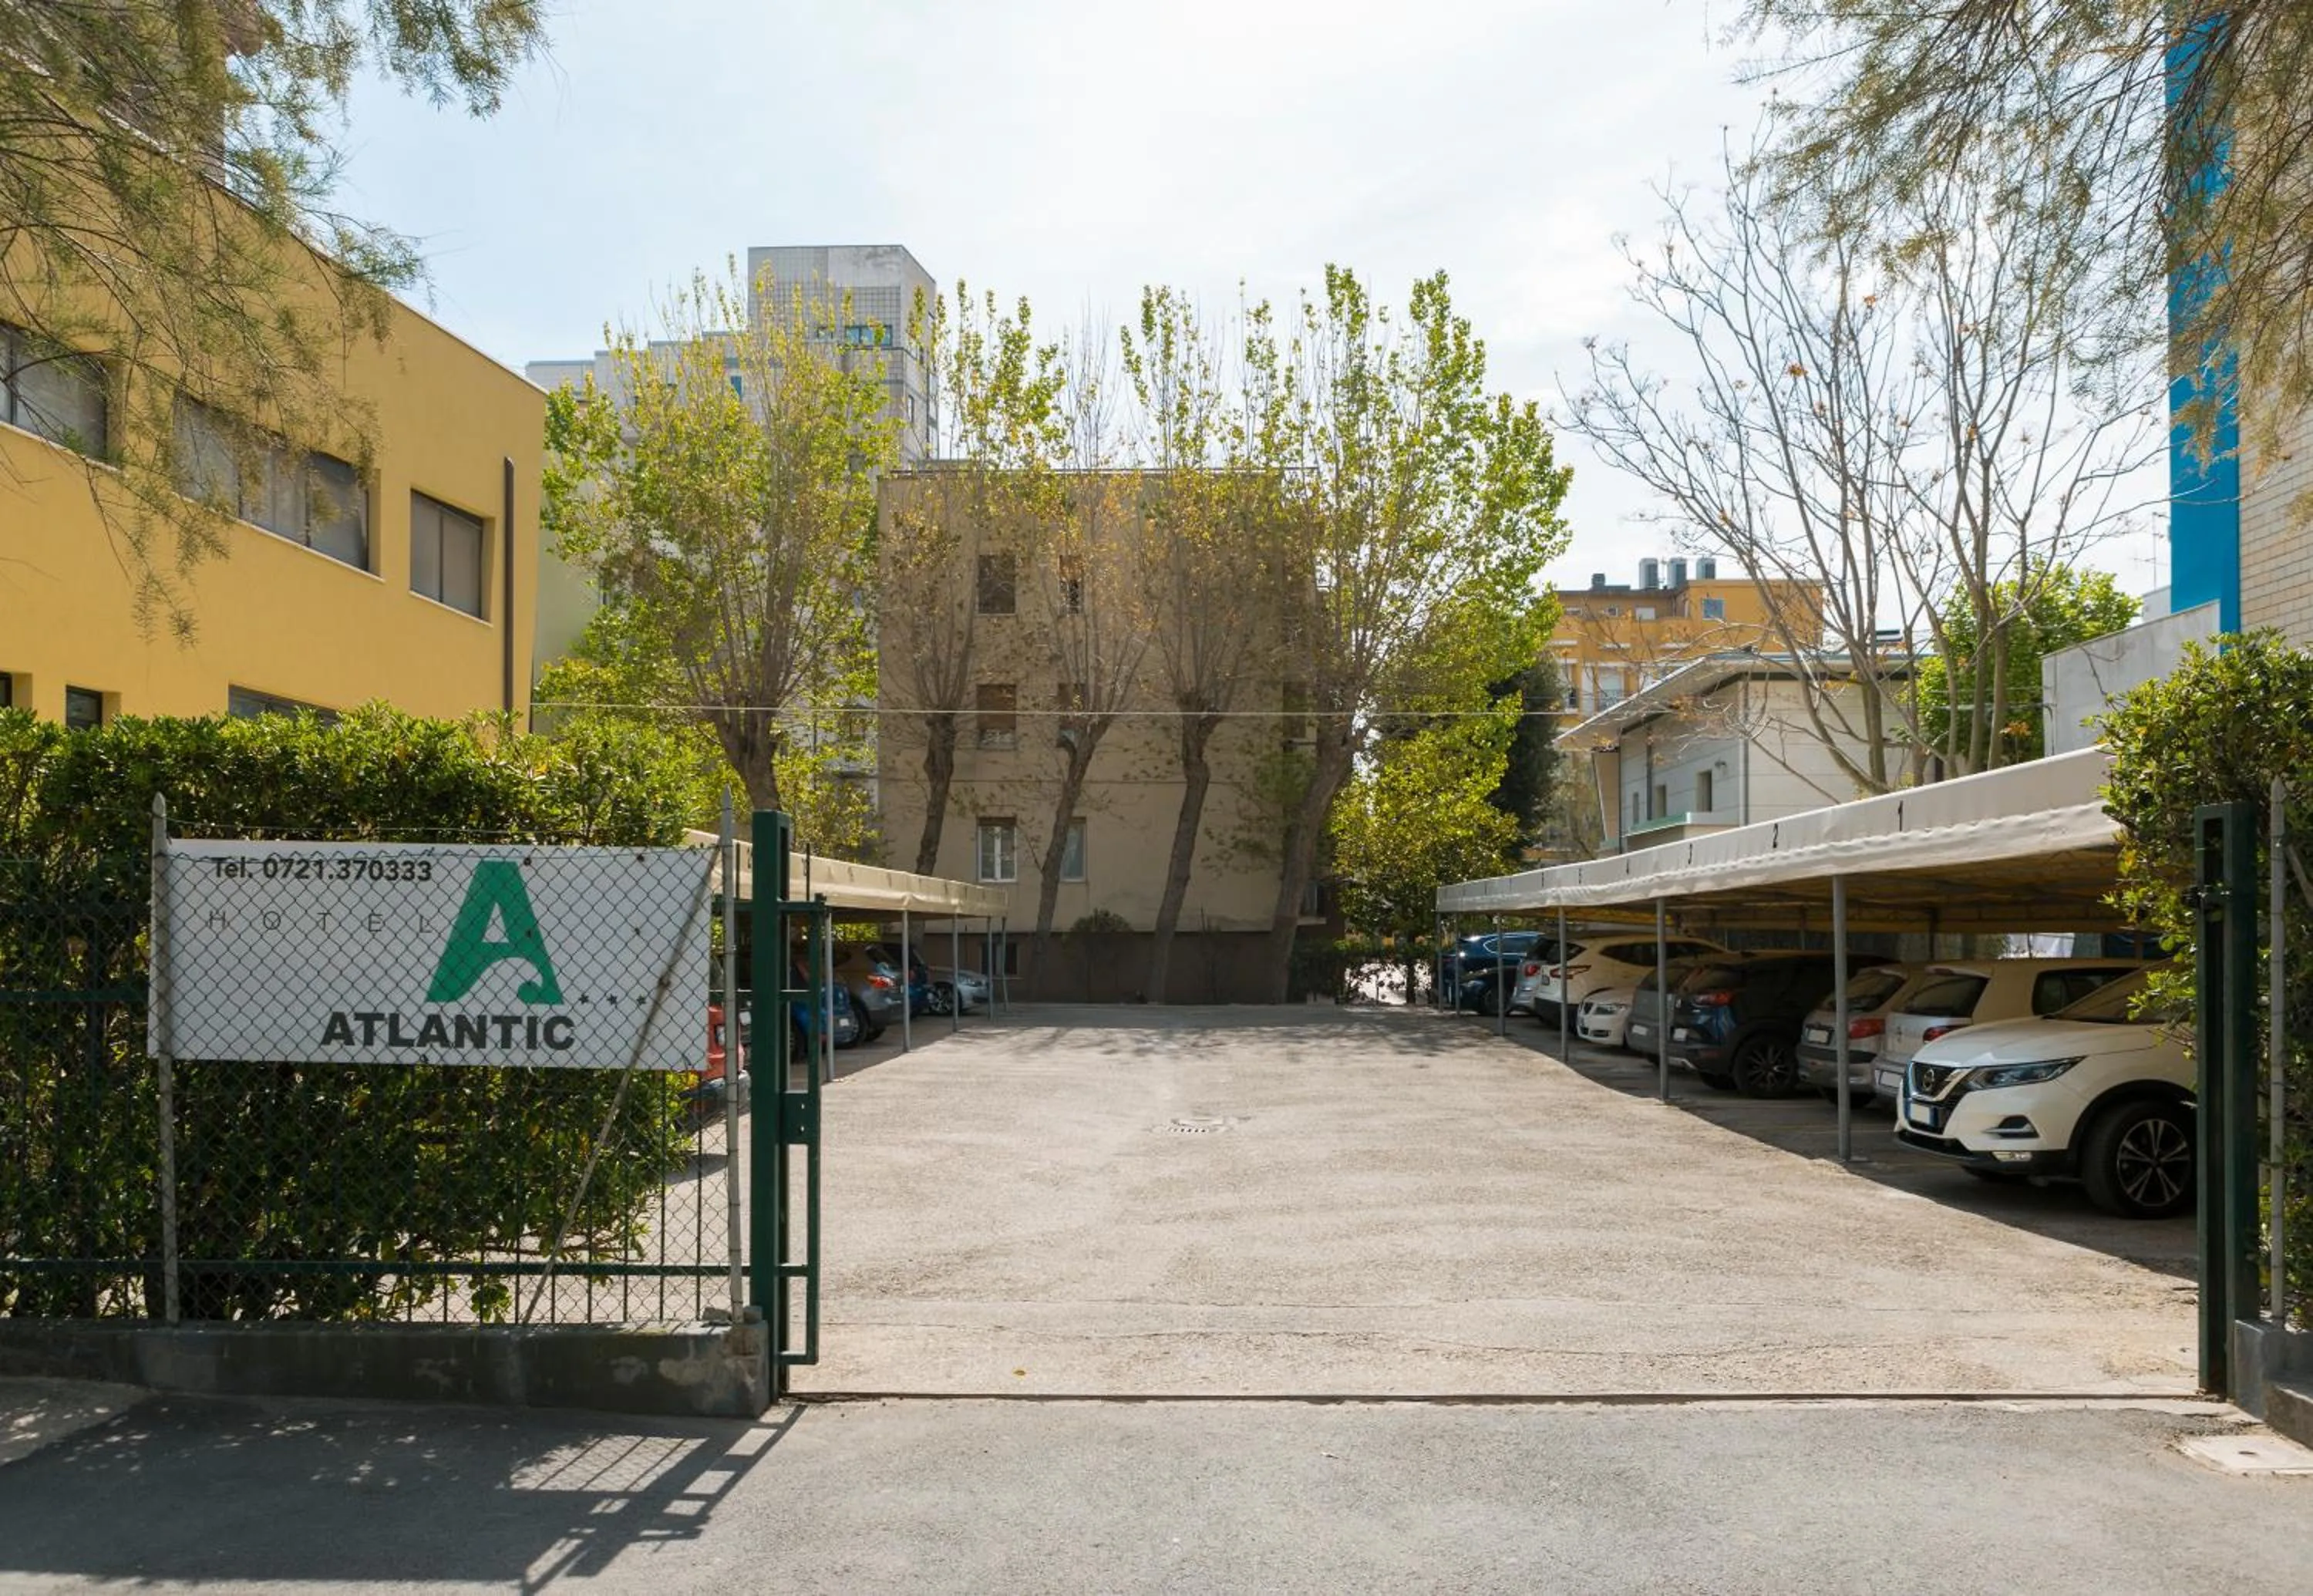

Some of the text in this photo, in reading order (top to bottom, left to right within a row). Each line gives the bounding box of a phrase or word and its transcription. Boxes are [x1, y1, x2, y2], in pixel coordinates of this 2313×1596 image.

[214, 857, 432, 881] Tel. 0721.370333
[208, 910, 433, 934] HOTEL
[321, 1011, 576, 1051] ATLANTIC
